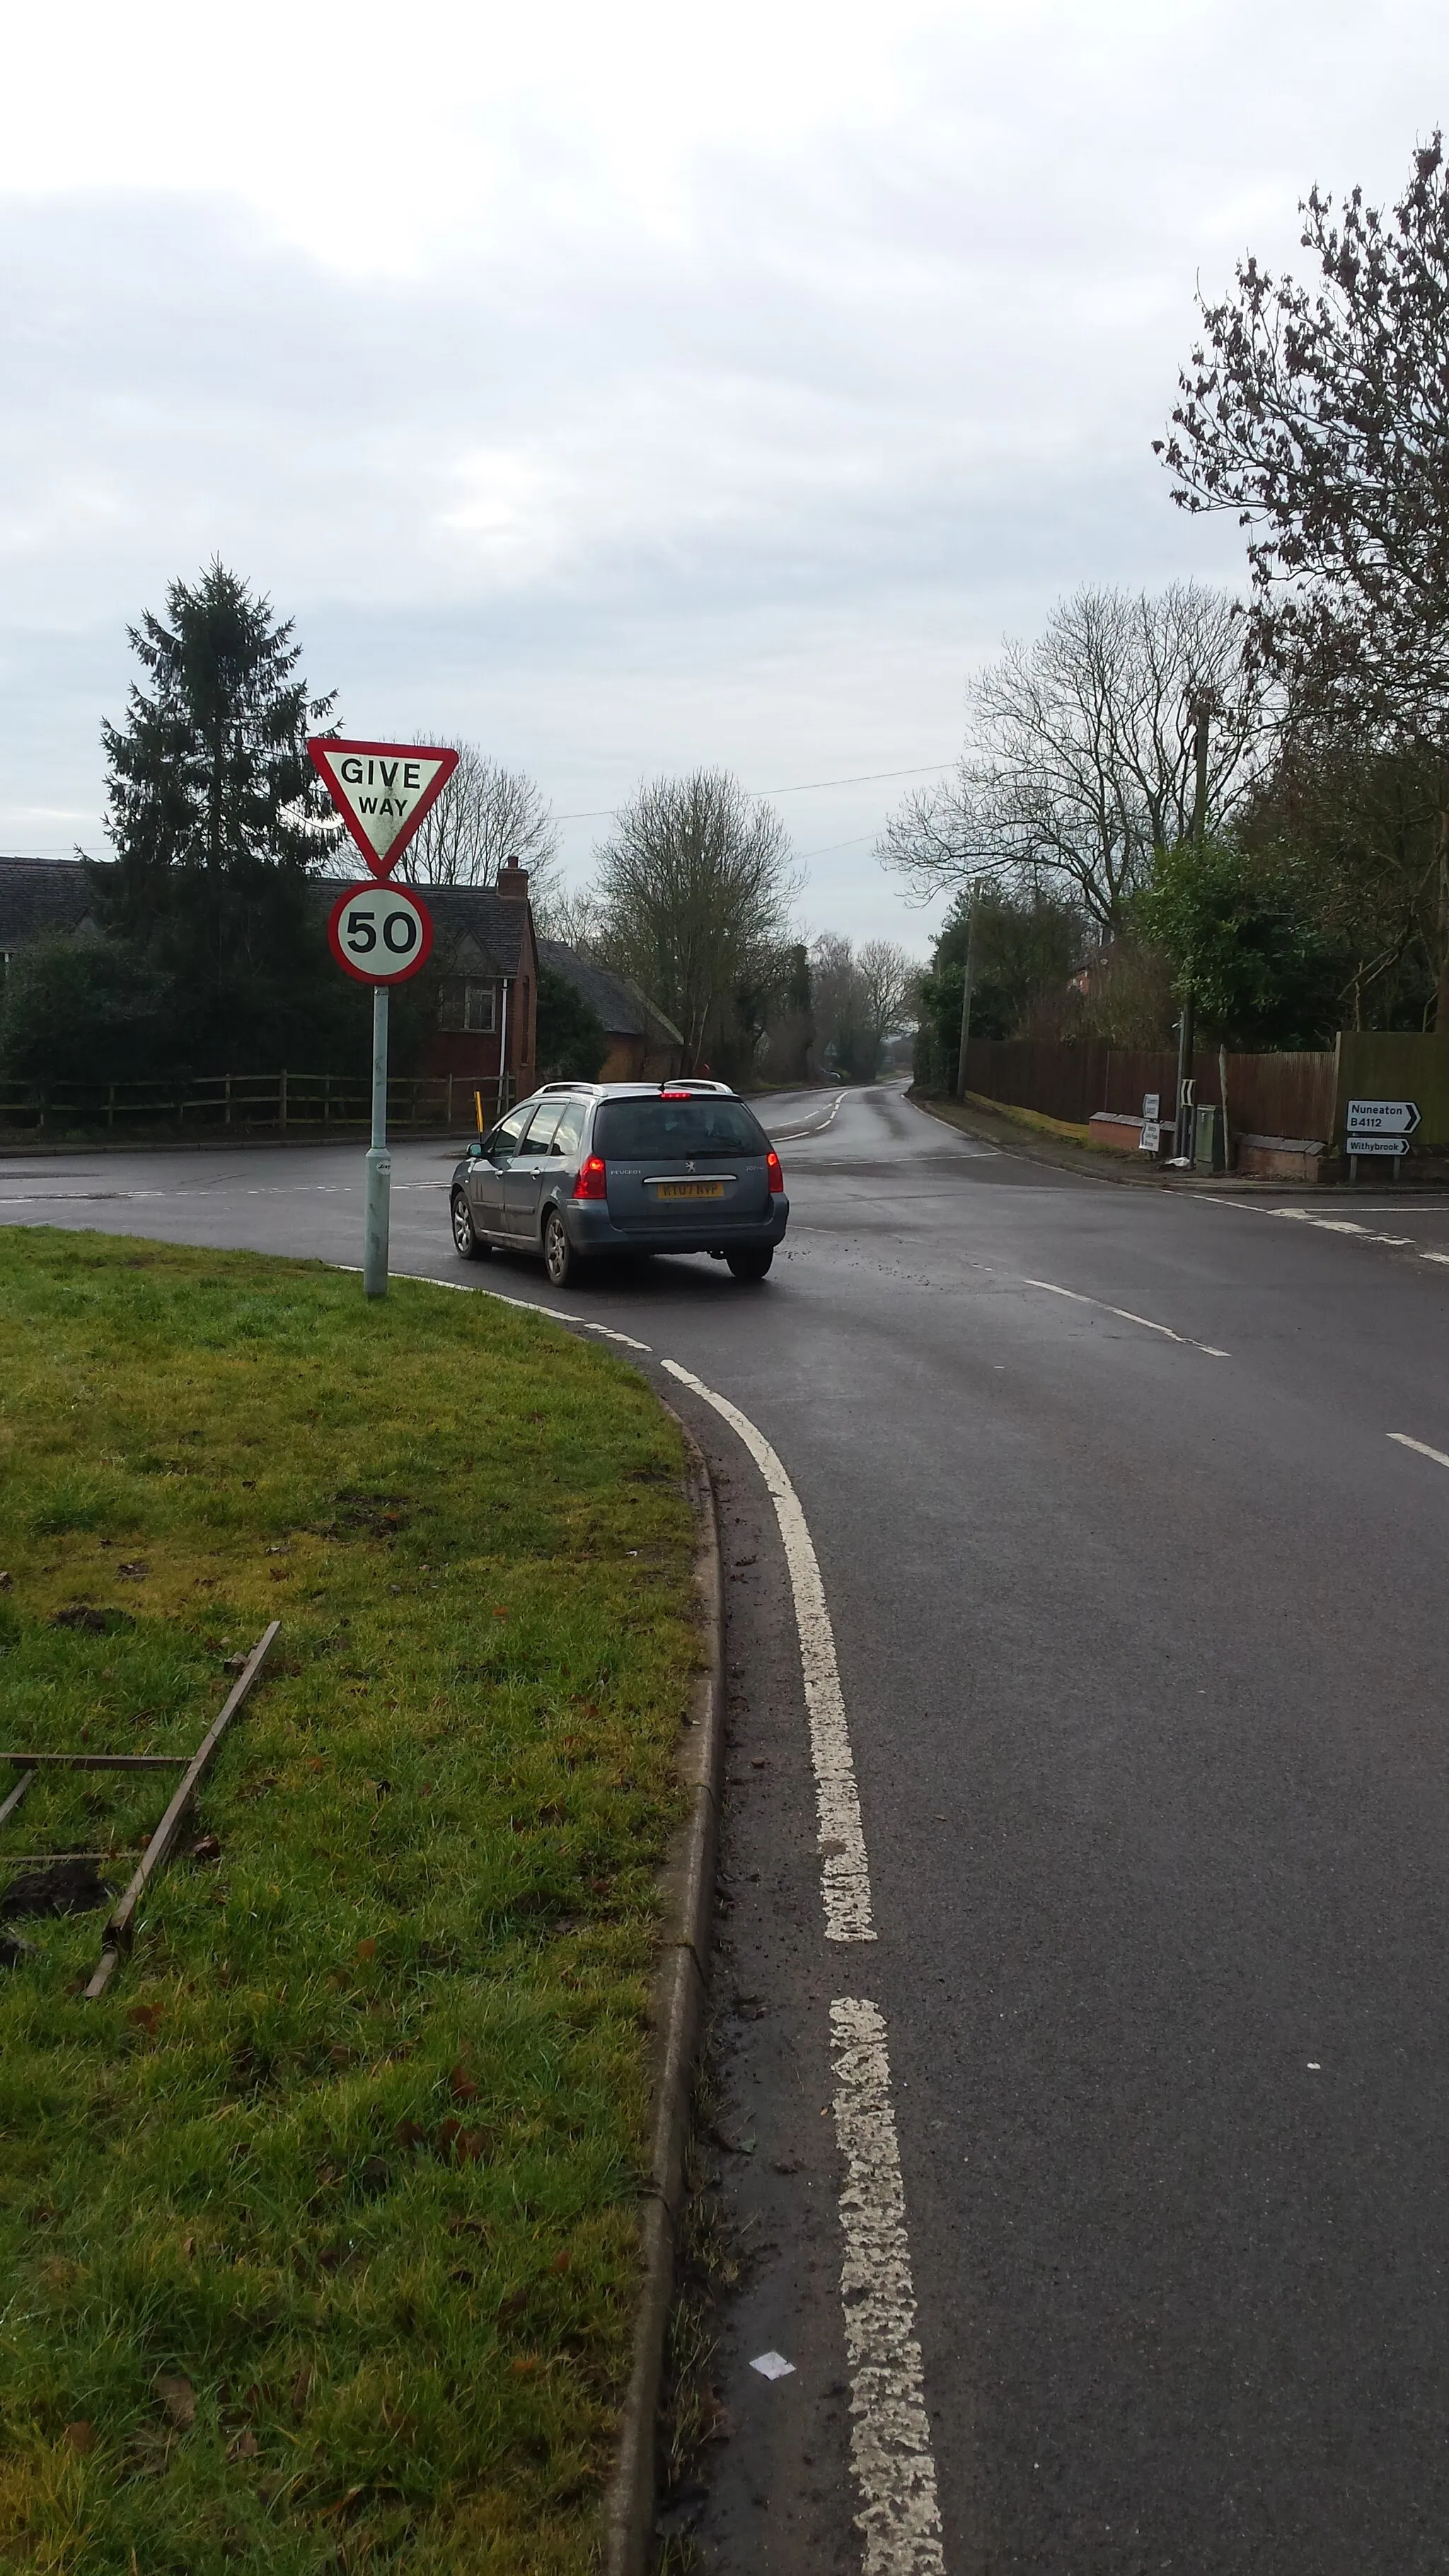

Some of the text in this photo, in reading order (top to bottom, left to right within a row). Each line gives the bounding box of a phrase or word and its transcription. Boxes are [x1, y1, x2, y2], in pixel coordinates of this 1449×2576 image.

[340, 758, 421, 789] GIVE
[359, 796, 408, 816] WAY
[347, 911, 417, 954] 50
[1351, 1104, 1402, 1115] Nuneaton
[1351, 1117, 1382, 1127] B4112
[1350, 1142, 1399, 1151] Withybrook
